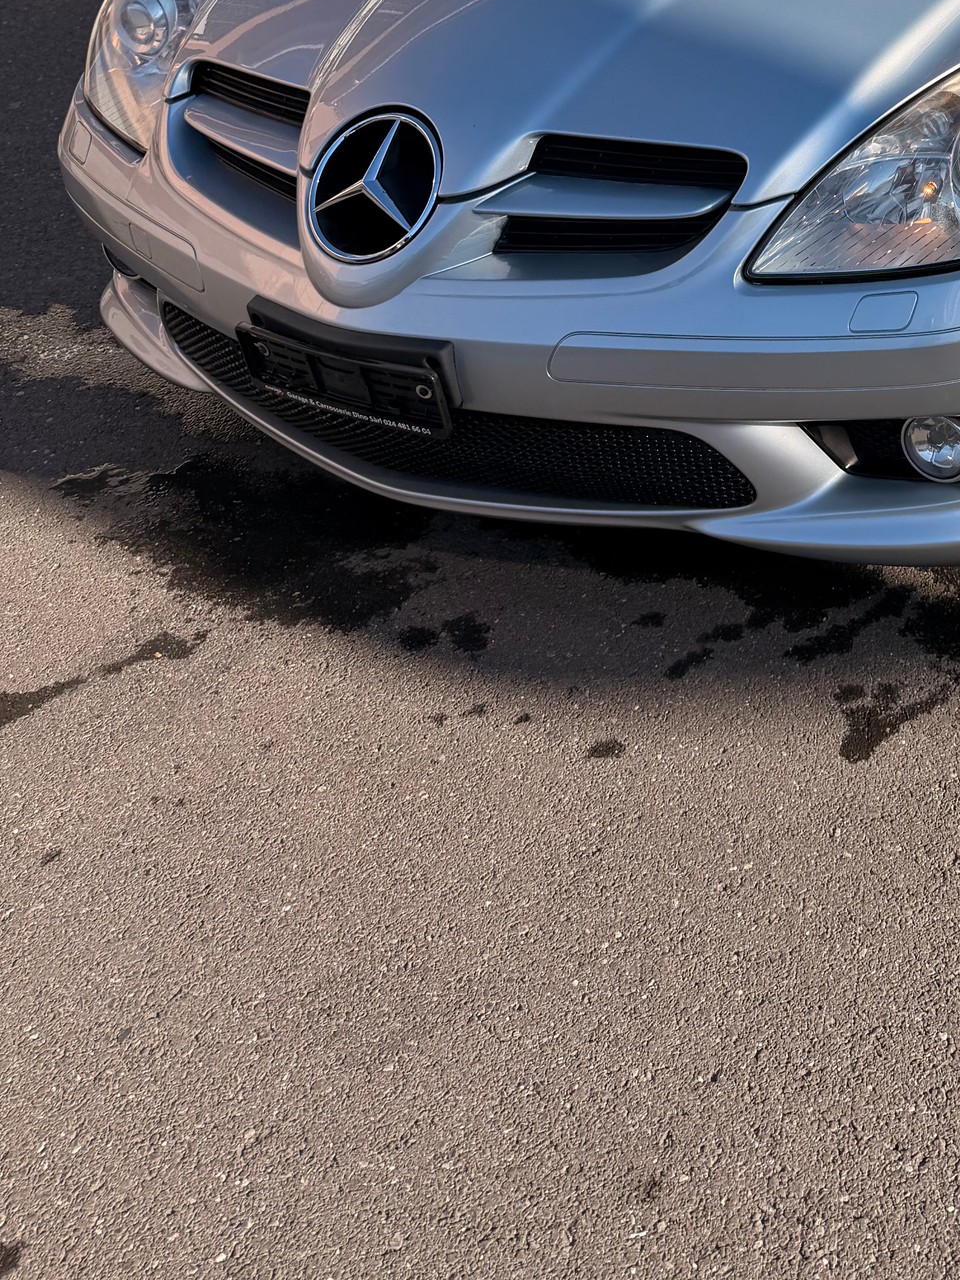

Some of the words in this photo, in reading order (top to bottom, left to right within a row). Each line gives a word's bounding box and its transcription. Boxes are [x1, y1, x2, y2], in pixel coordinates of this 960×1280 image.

[287, 391, 309, 404] Garage
[309, 398, 316, 406] &
[315, 401, 352, 417] Carrosserie
[352, 411, 369, 421] Dino
[383, 419, 397, 428] 024
